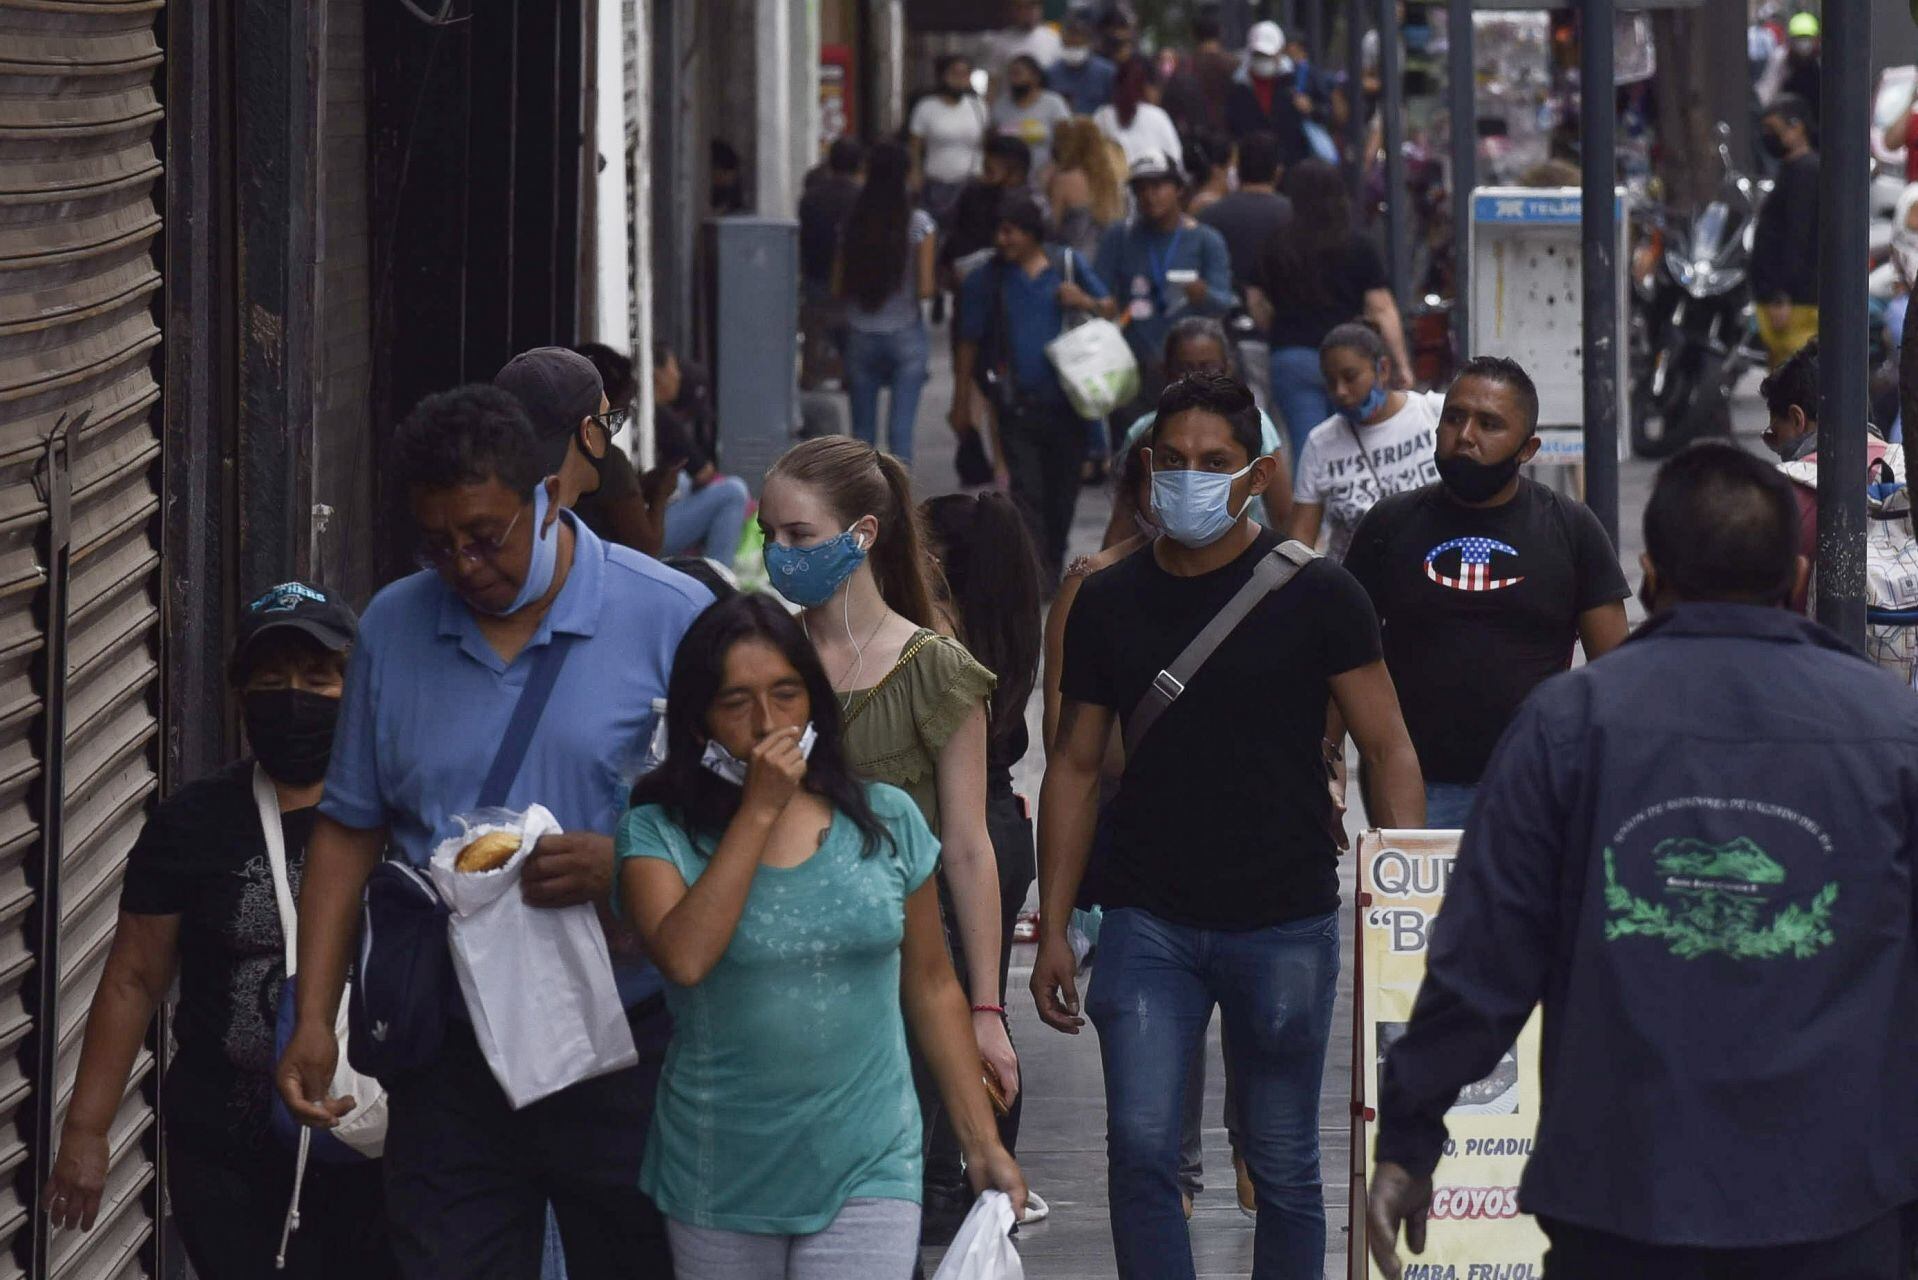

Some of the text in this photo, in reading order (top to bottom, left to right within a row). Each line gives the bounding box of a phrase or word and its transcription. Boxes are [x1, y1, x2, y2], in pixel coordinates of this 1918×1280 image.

[1530, 201, 1581, 215] TELM
[1328, 430, 1432, 477] IT'S FRIDAY
[1370, 911, 1436, 952] “B
[1442, 1138, 1534, 1158] O, PICADIL
[1428, 1187, 1520, 1219] COYOS
